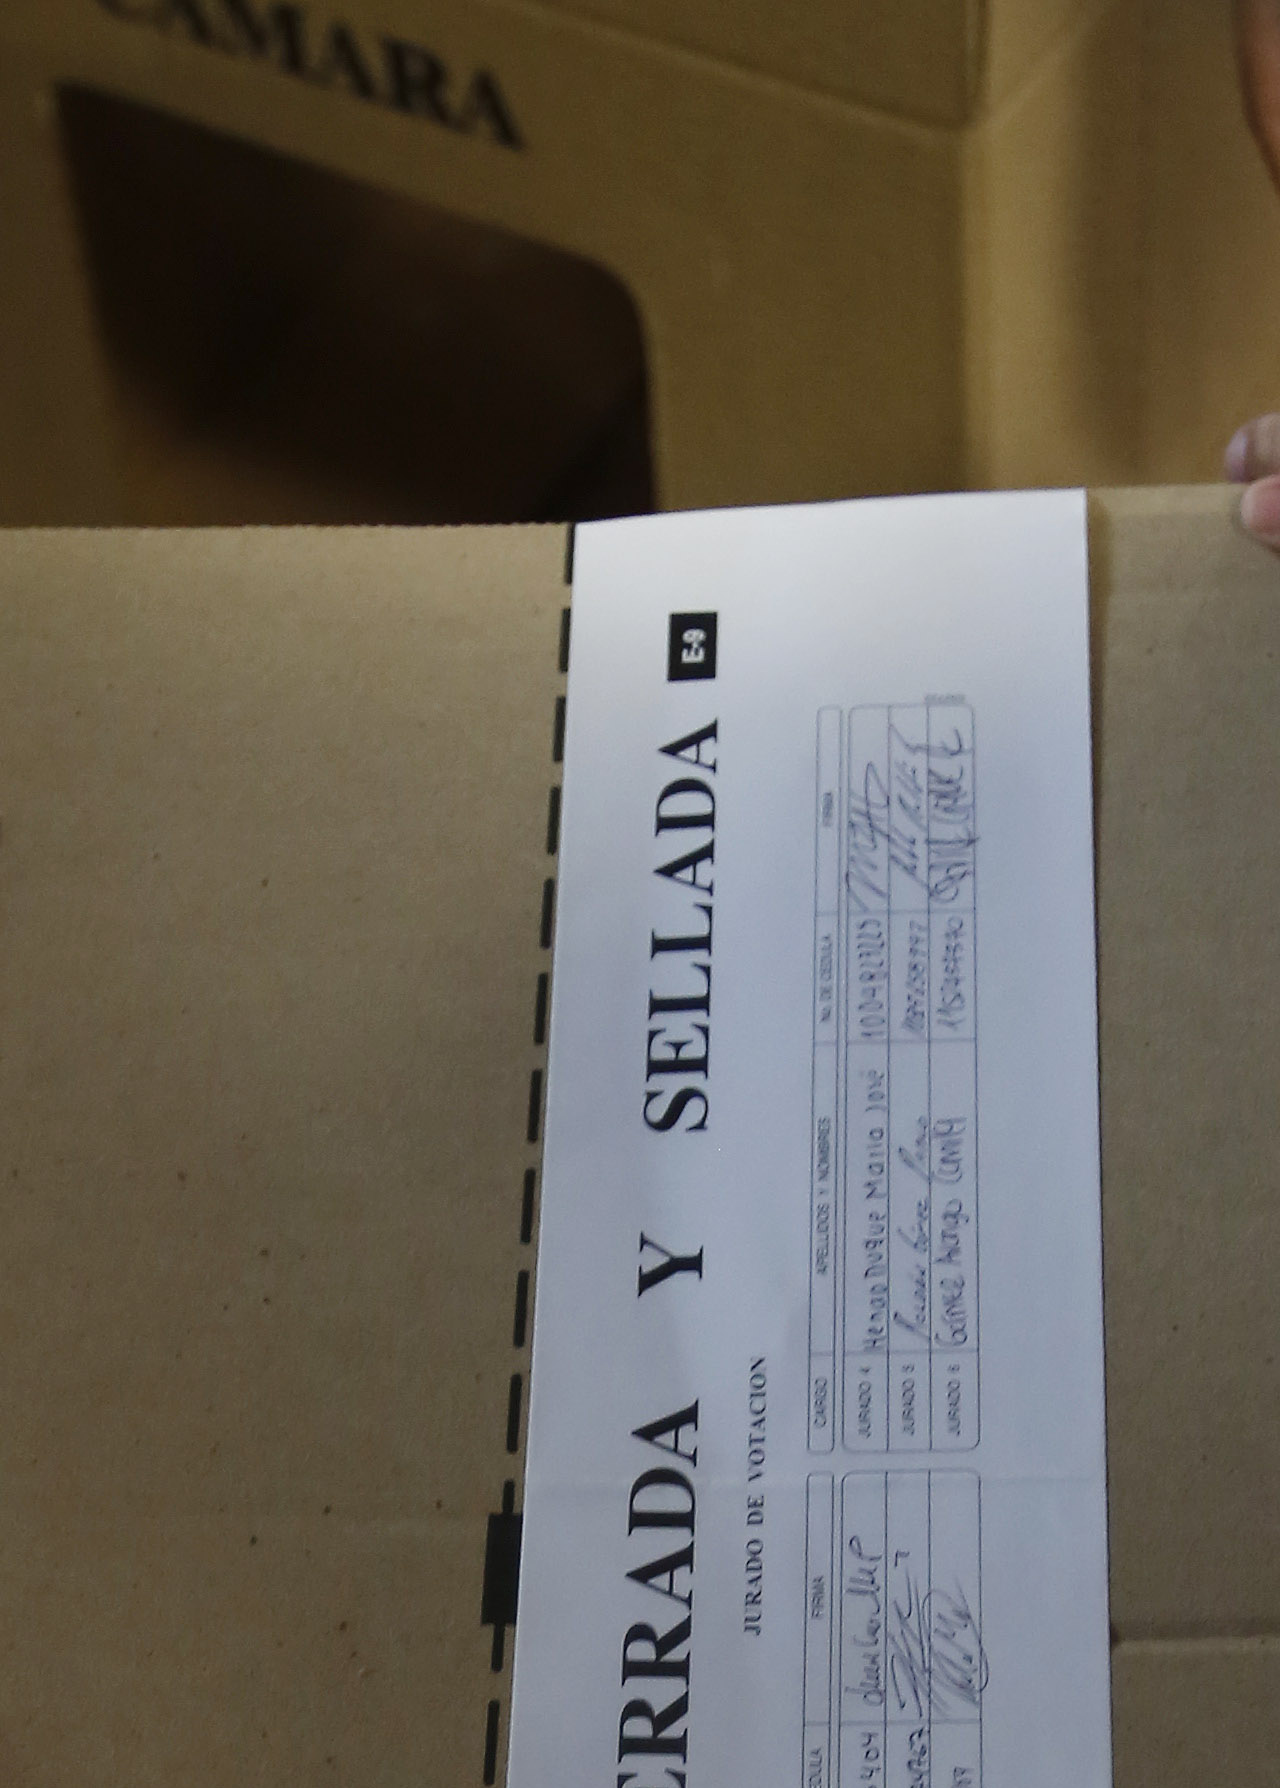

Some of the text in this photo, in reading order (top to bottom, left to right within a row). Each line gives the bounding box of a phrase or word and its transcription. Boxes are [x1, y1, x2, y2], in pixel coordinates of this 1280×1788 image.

[96, 0, 526, 152] AMARA
[680, 628, 707, 663] E-9
[642, 719, 718, 1134] SELLADA
[637, 1232, 703, 1297] Y
[742, 1355, 767, 1636] JURADO DE VOTACION
